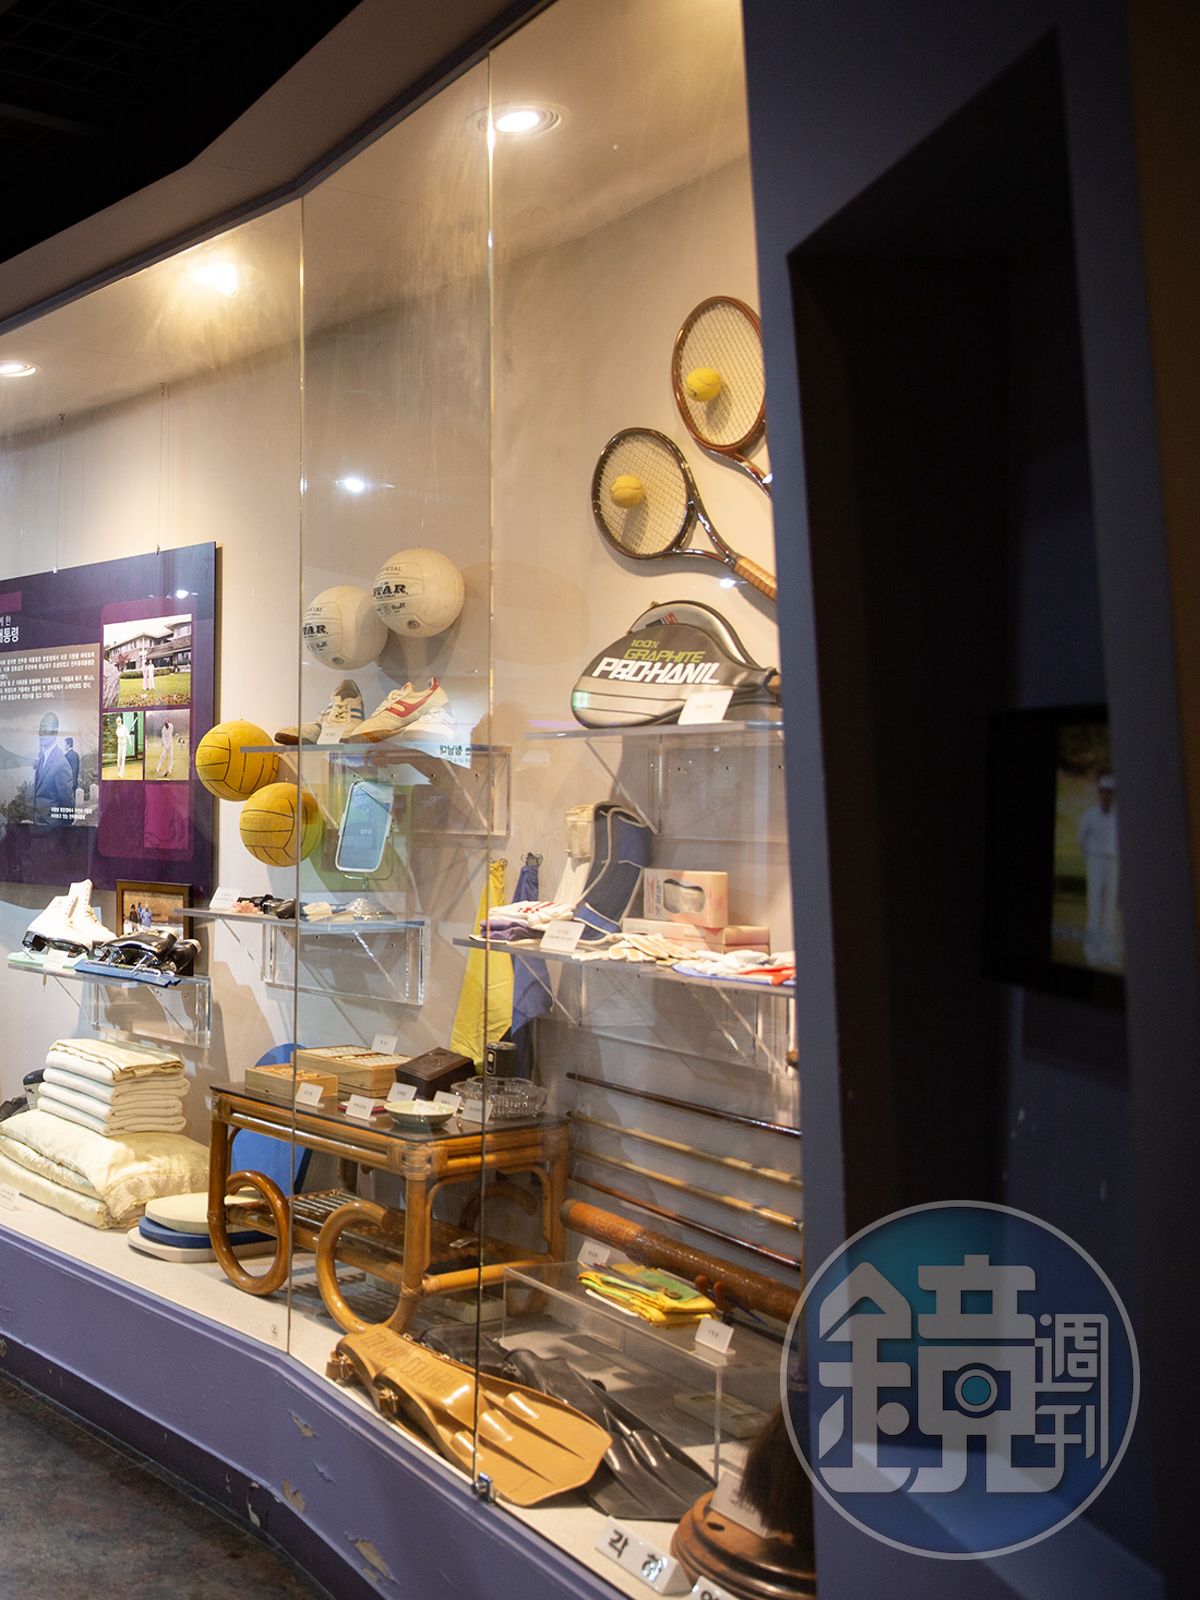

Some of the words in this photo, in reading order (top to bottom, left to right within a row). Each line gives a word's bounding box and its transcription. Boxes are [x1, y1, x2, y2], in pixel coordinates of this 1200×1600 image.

[5, 615, 12, 627] 한
[630, 639, 660, 649] 100%
[623, 648, 706, 663] GRAPHITE
